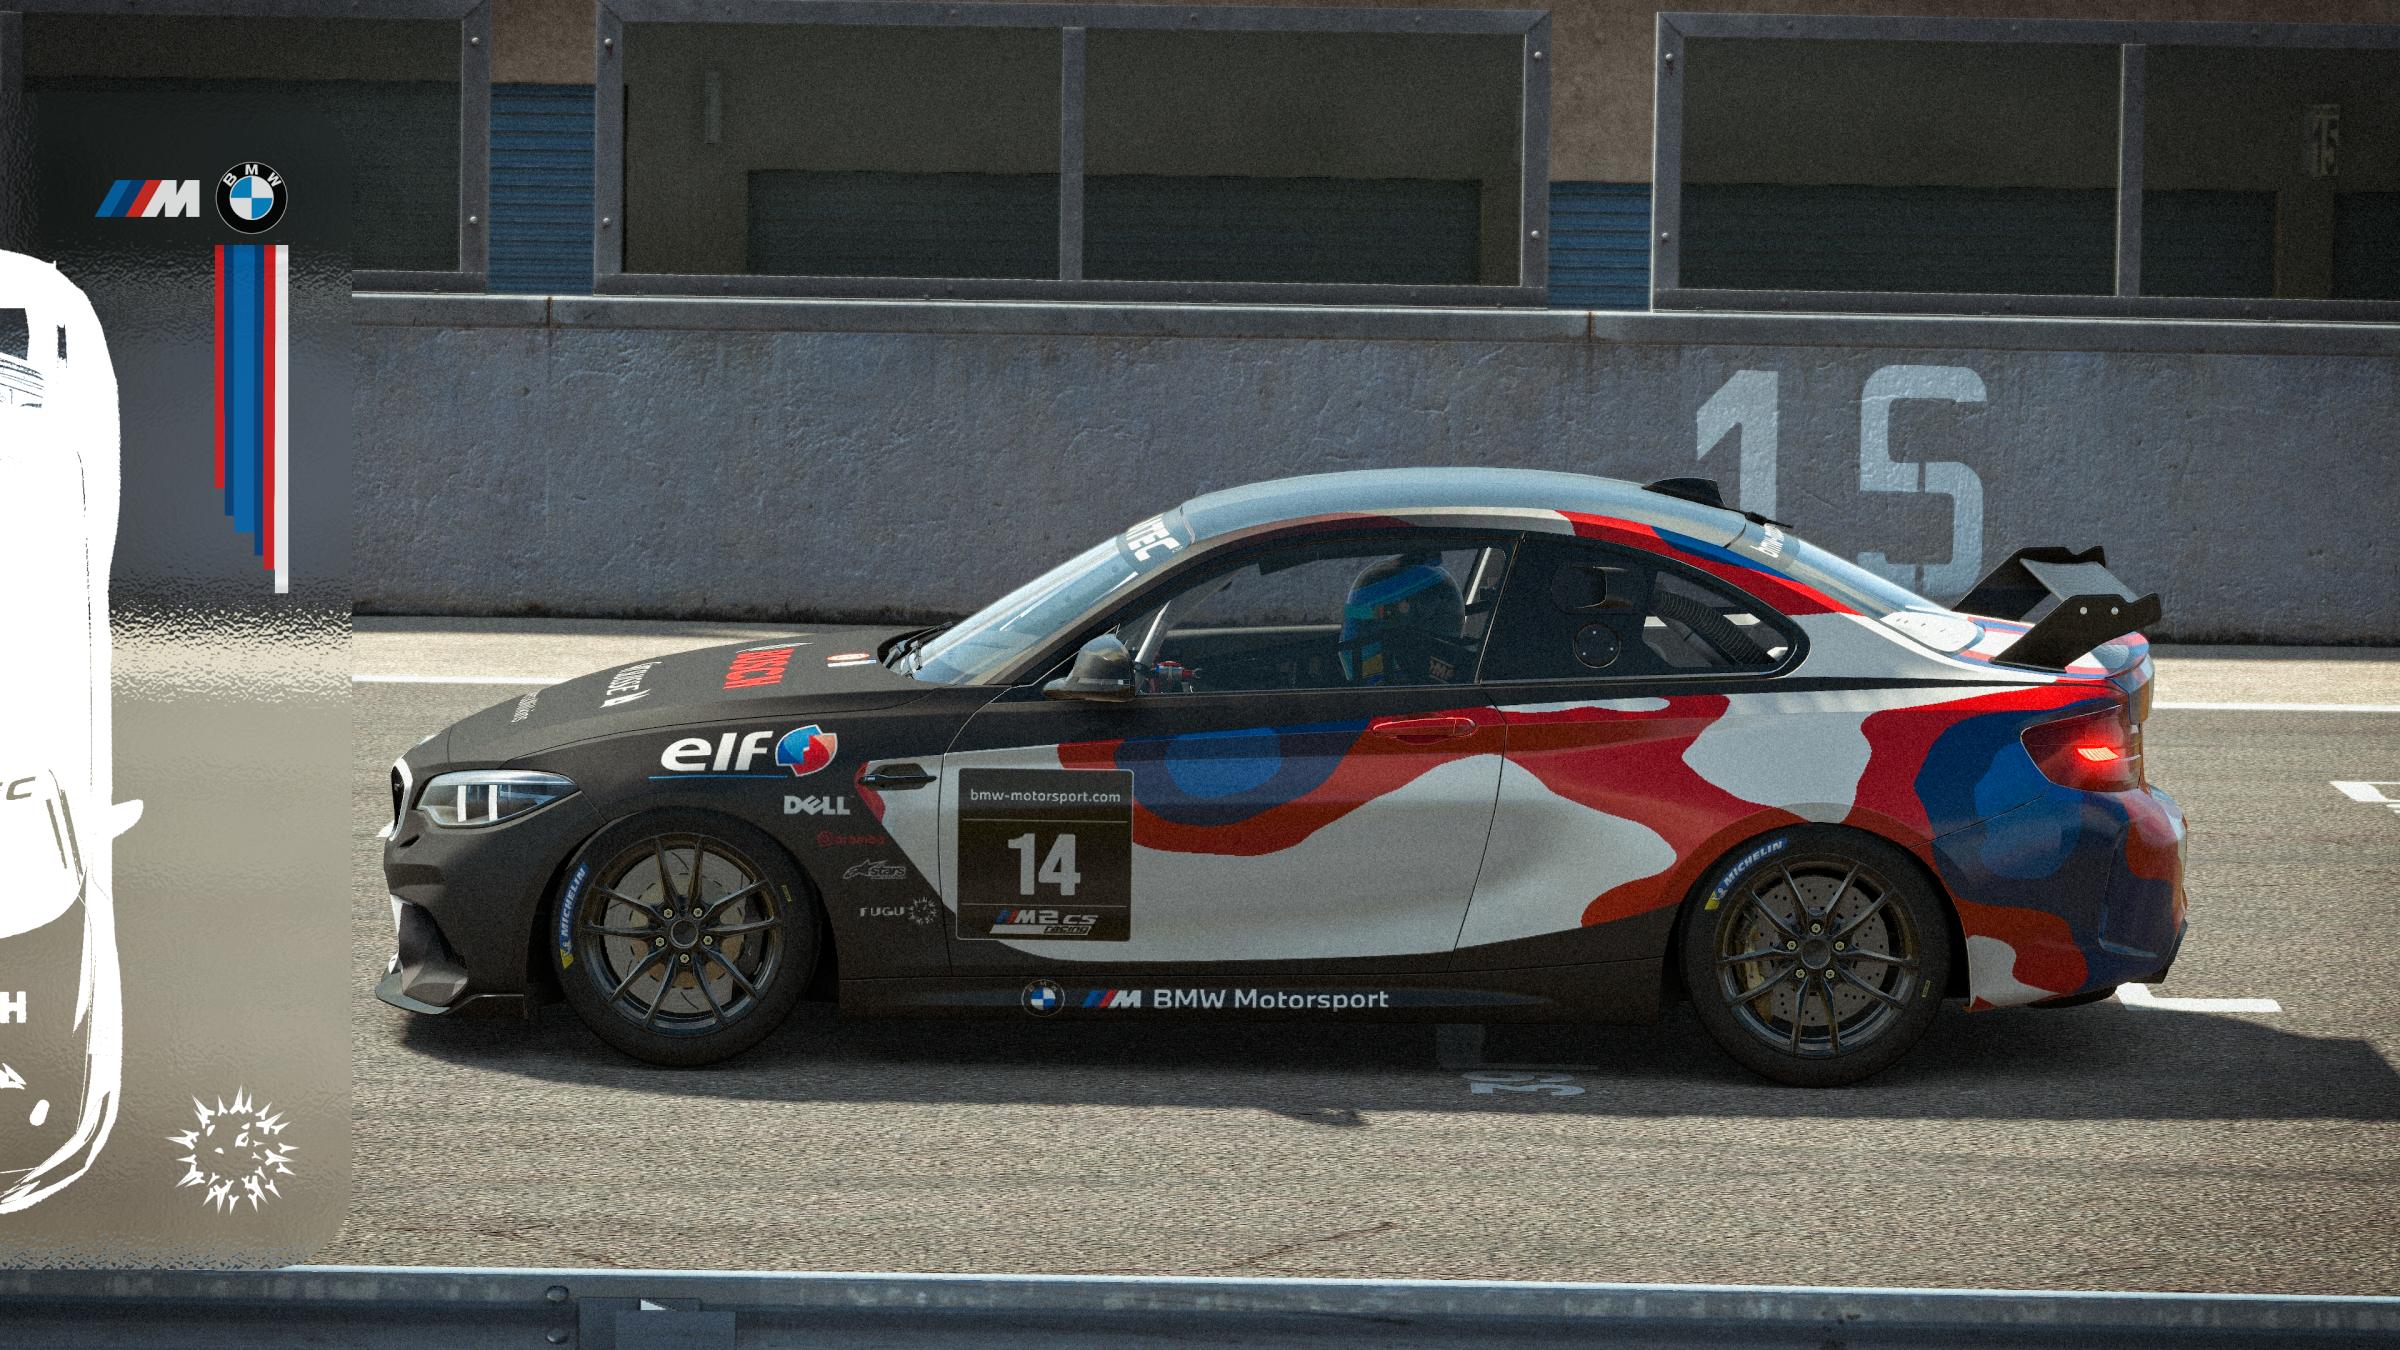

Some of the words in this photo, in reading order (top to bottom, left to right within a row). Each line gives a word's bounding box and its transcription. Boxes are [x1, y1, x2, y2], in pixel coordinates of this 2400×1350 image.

[1696, 364, 1987, 599] 15
[1126, 513, 1180, 562] TEC
[661, 730, 774, 771] elf
[784, 795, 850, 815] DELL
[970, 788, 1121, 805] bmw-motorsport.com
[1007, 833, 1081, 896] 14
[1723, 840, 1783, 887] MICHELIN
[561, 867, 586, 937] MICHELIN
[1153, 988, 1227, 1009] BMW
[1235, 988, 1389, 1013] Motorsport
